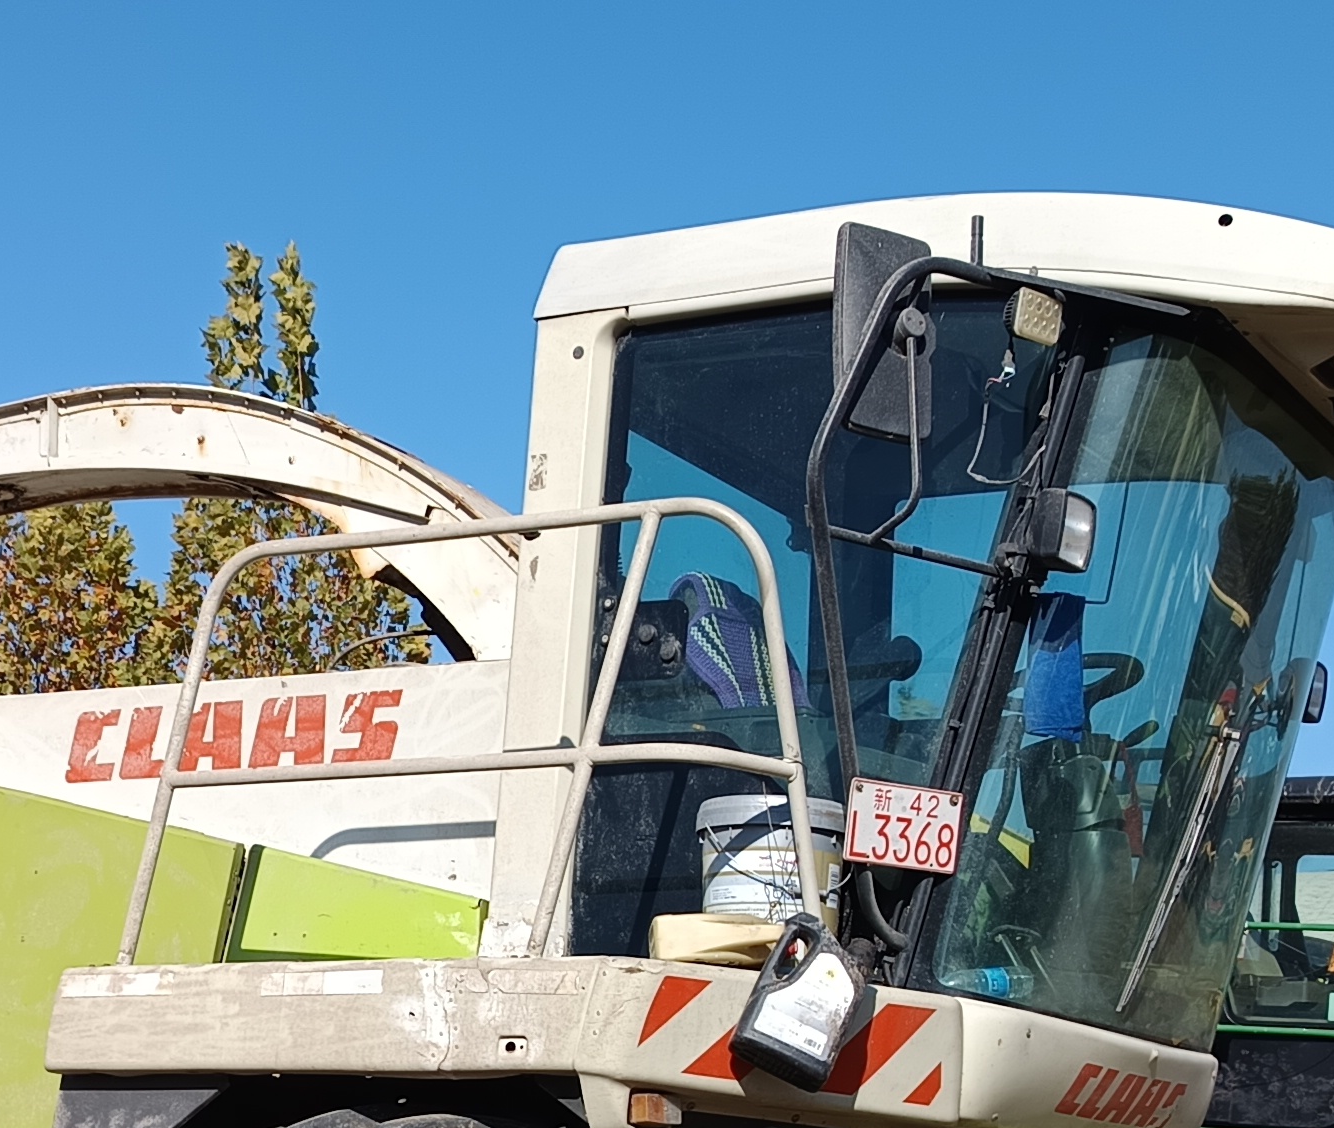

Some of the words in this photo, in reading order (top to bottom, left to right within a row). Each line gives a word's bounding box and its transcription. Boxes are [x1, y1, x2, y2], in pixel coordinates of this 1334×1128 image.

[65, 689, 403, 783] CLAAS
[873, 788, 893, 813] 新
[910, 792, 940, 819] 42
[849, 810, 955, 869] L3368
